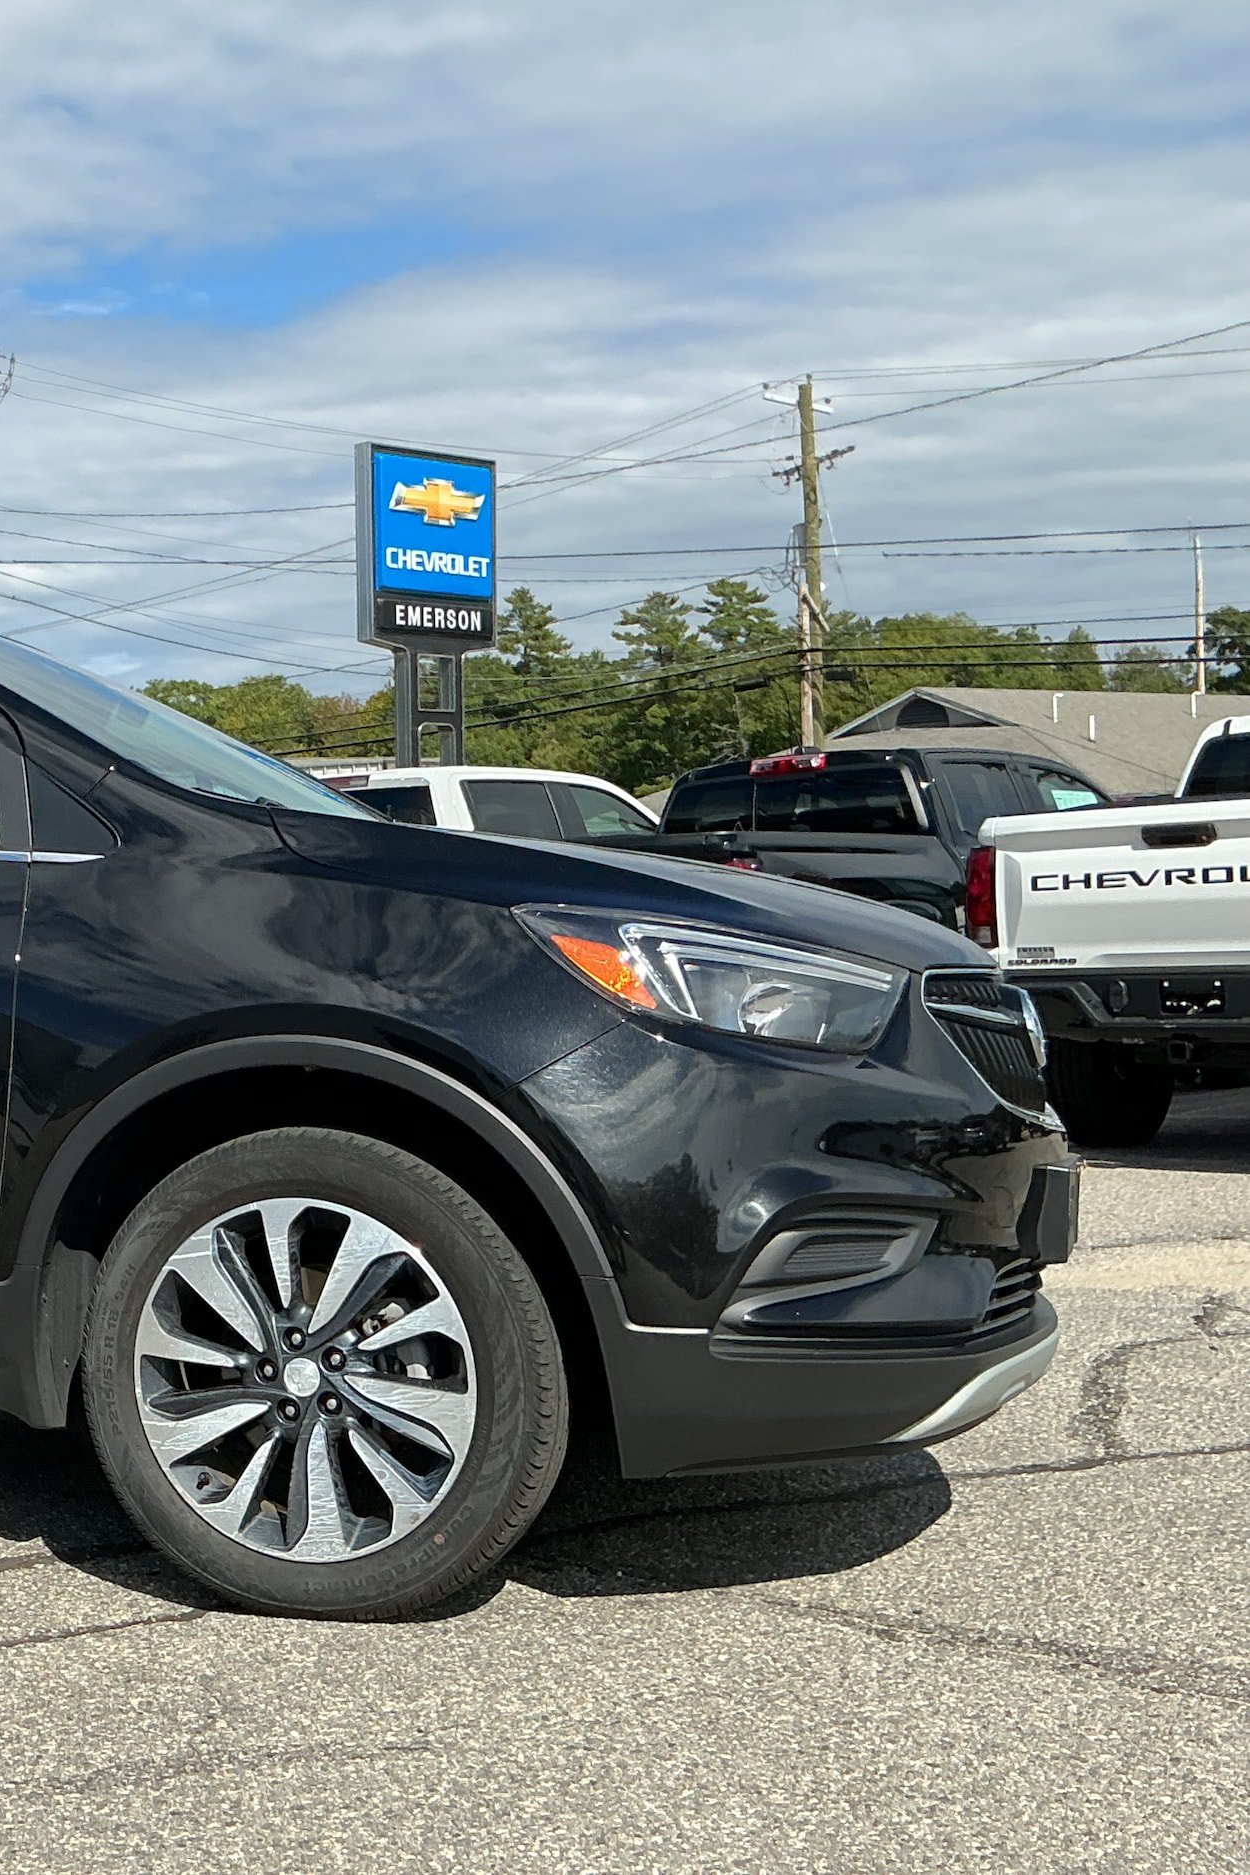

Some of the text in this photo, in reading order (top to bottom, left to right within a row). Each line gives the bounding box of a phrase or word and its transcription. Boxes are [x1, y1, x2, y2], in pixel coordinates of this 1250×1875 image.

[385, 546, 490, 578] CHEVROLET
[395, 604, 482, 631] EMERSON
[1007, 958, 1077, 966] COLORADO
